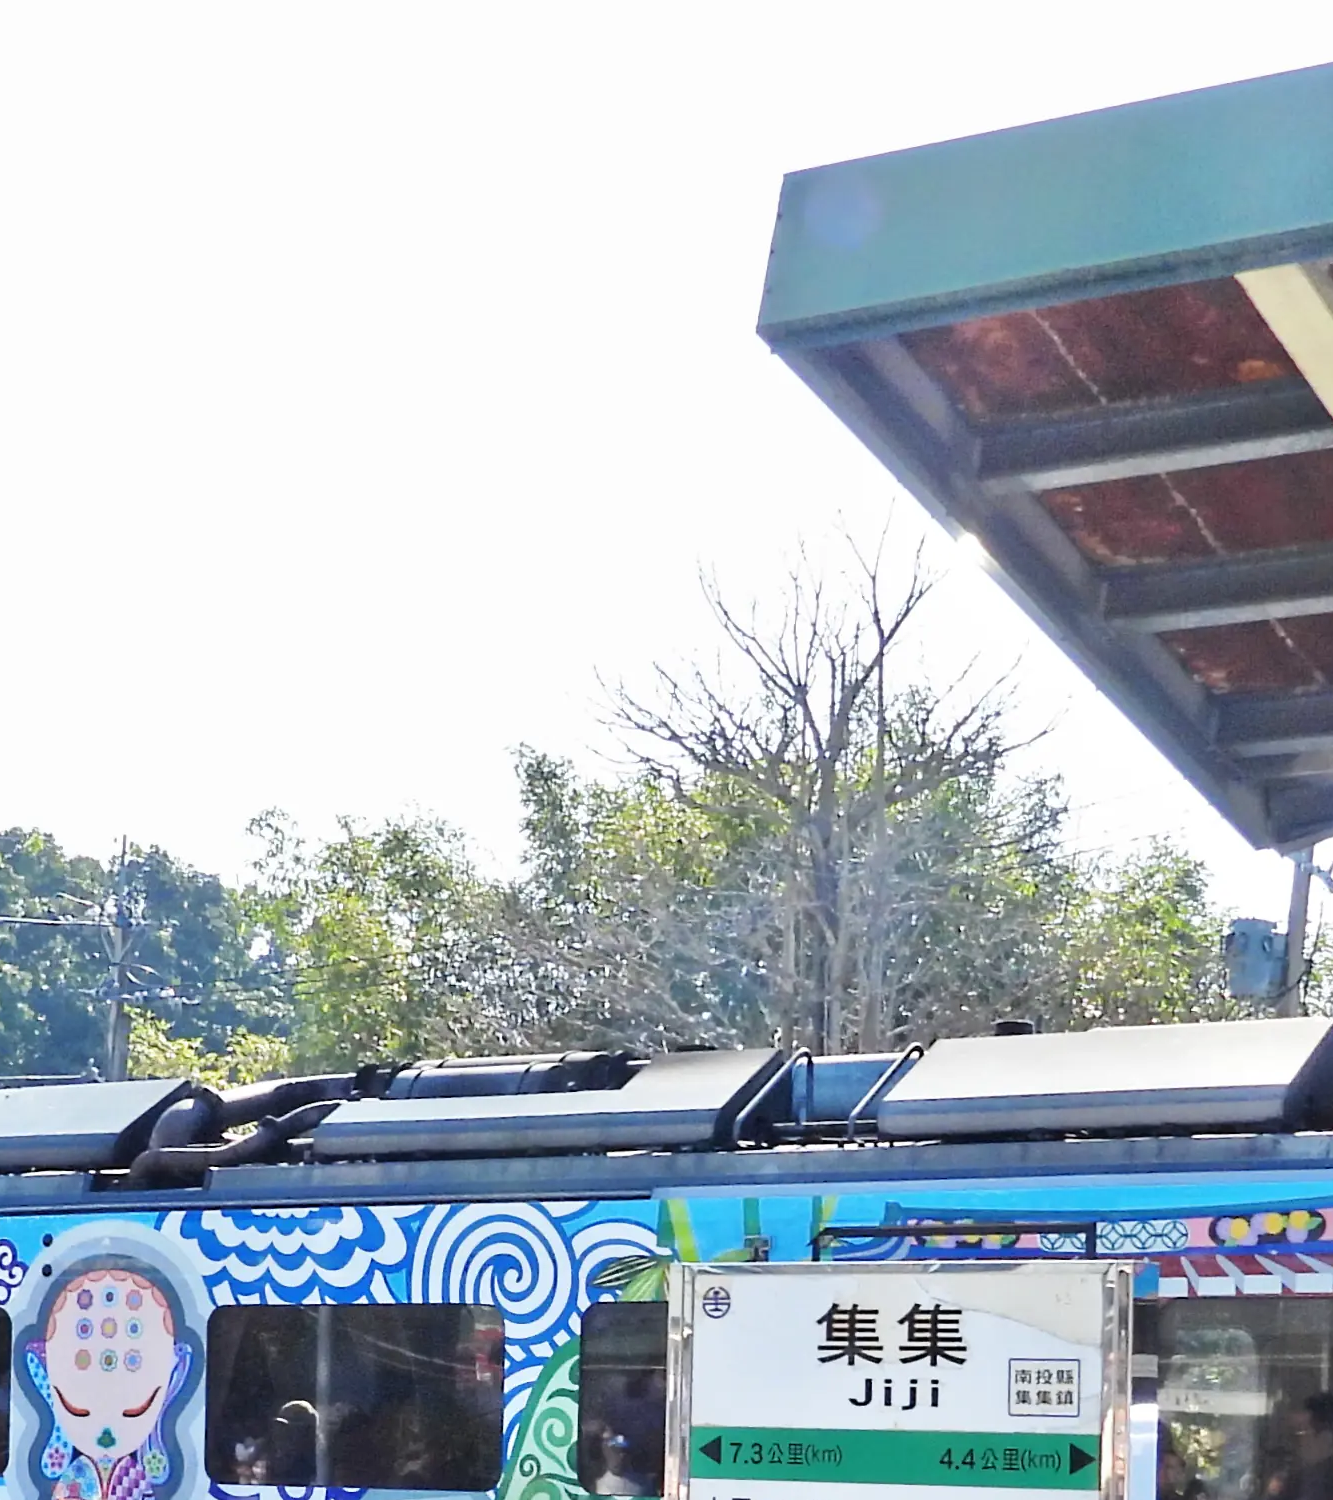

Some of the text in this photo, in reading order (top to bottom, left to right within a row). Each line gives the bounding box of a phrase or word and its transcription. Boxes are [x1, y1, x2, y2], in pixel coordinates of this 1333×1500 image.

[817, 1303, 968, 1366] 集集
[1014, 1369, 1074, 1385] 南投縣
[849, 1378, 940, 1410] Jiji
[1014, 1389, 1074, 1406] 集集鎮
